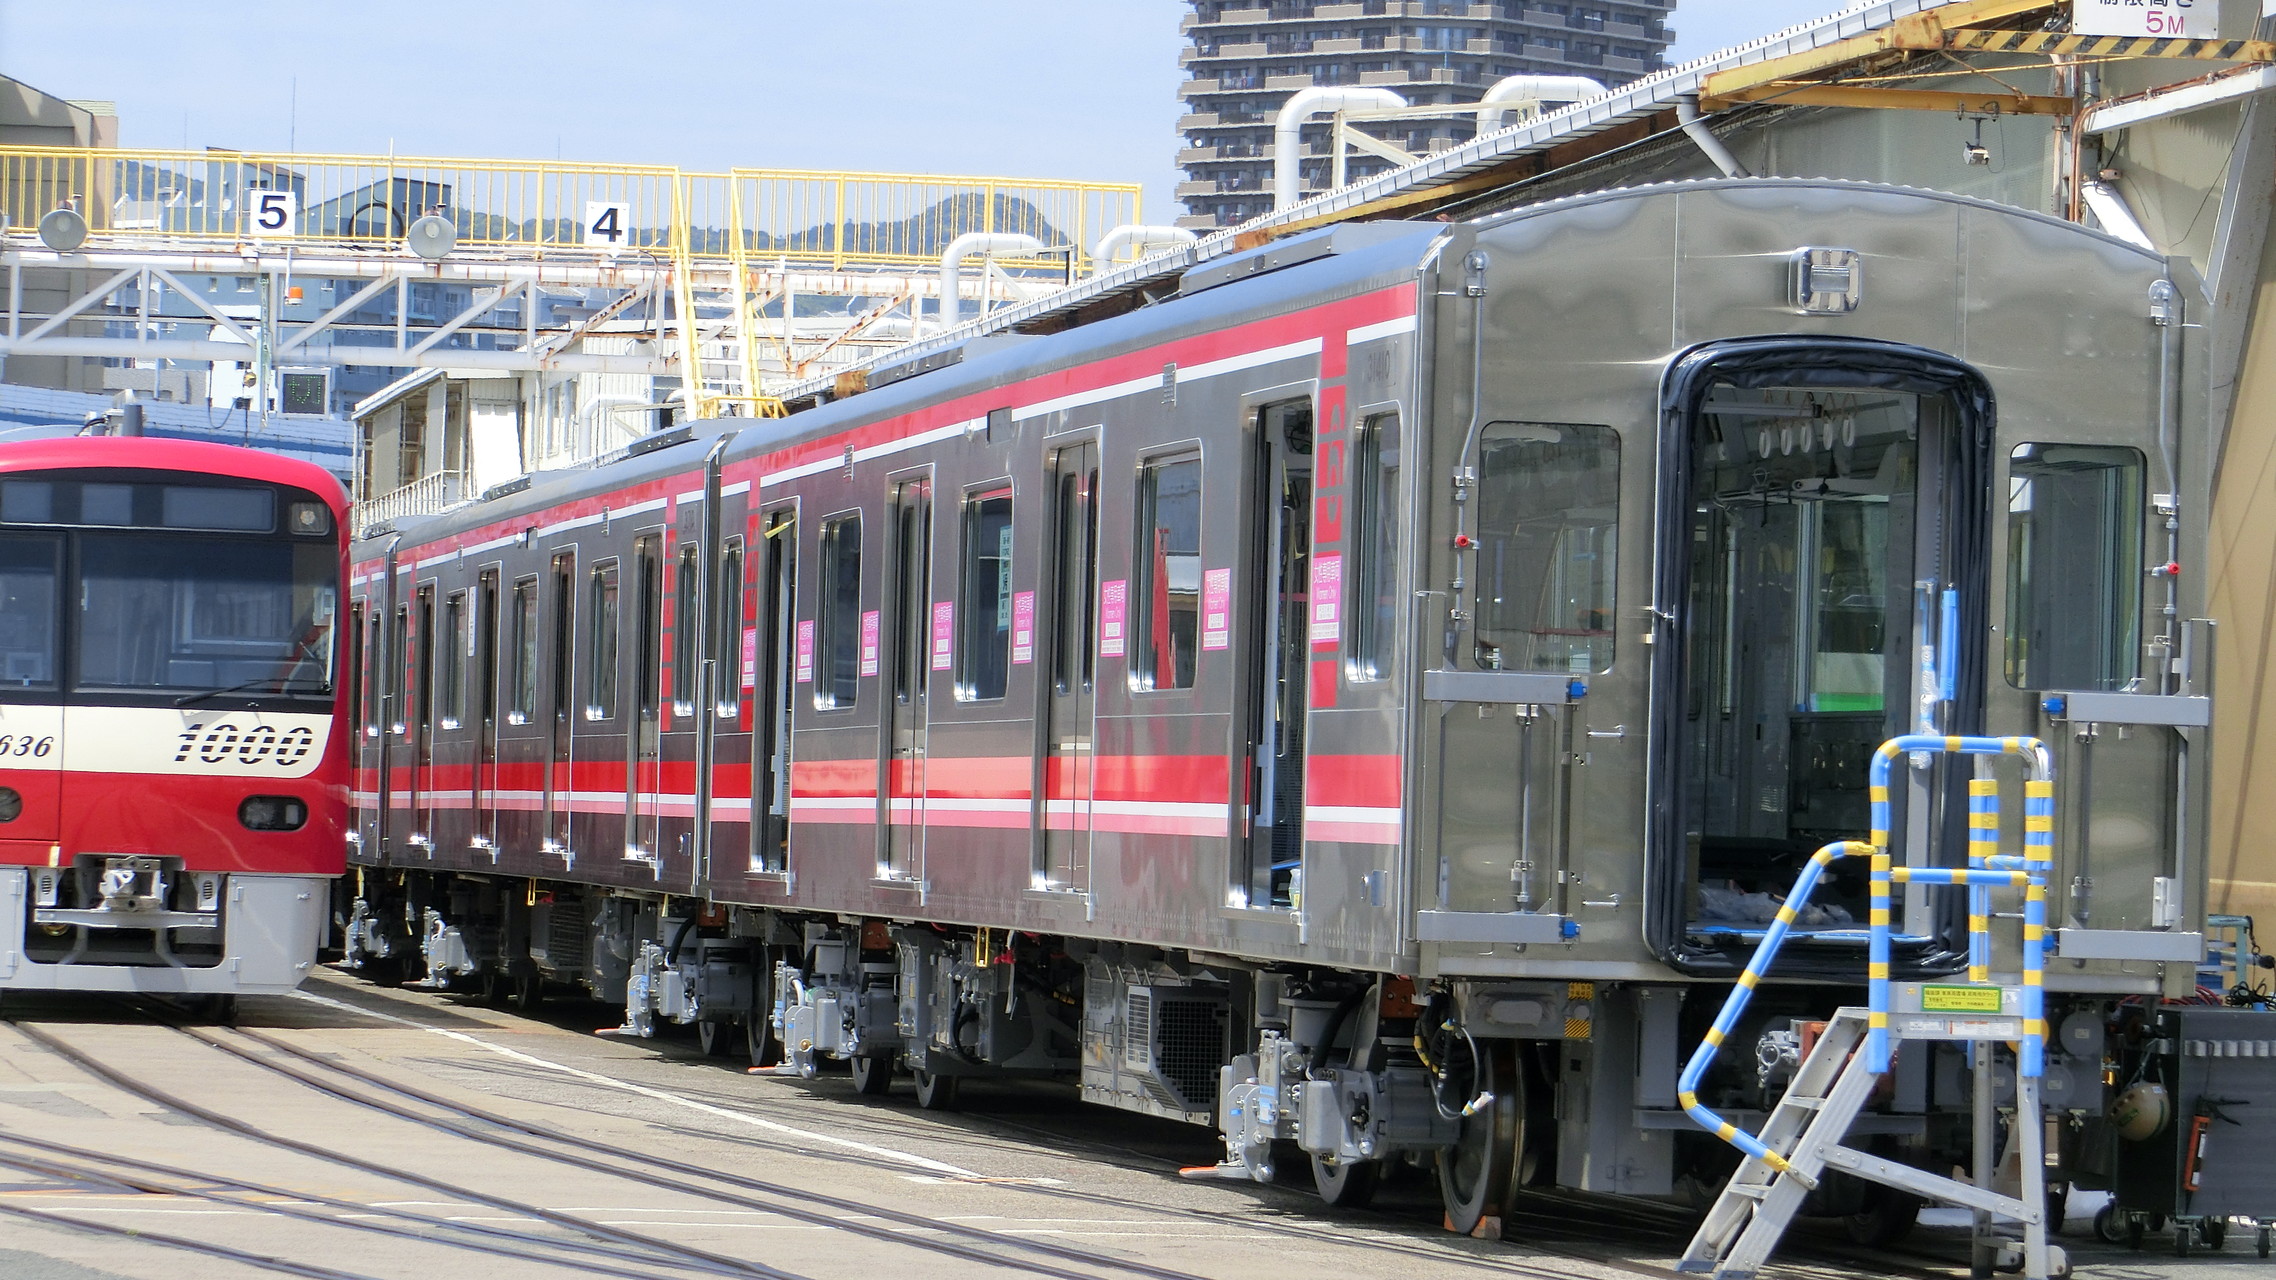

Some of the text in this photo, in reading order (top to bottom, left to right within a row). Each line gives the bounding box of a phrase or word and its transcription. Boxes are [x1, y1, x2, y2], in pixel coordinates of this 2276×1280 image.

[2146, 11, 2184, 34] 5M
[258, 195, 287, 230] 5
[592, 207, 622, 242] 4
[175, 723, 312, 766] 1000
